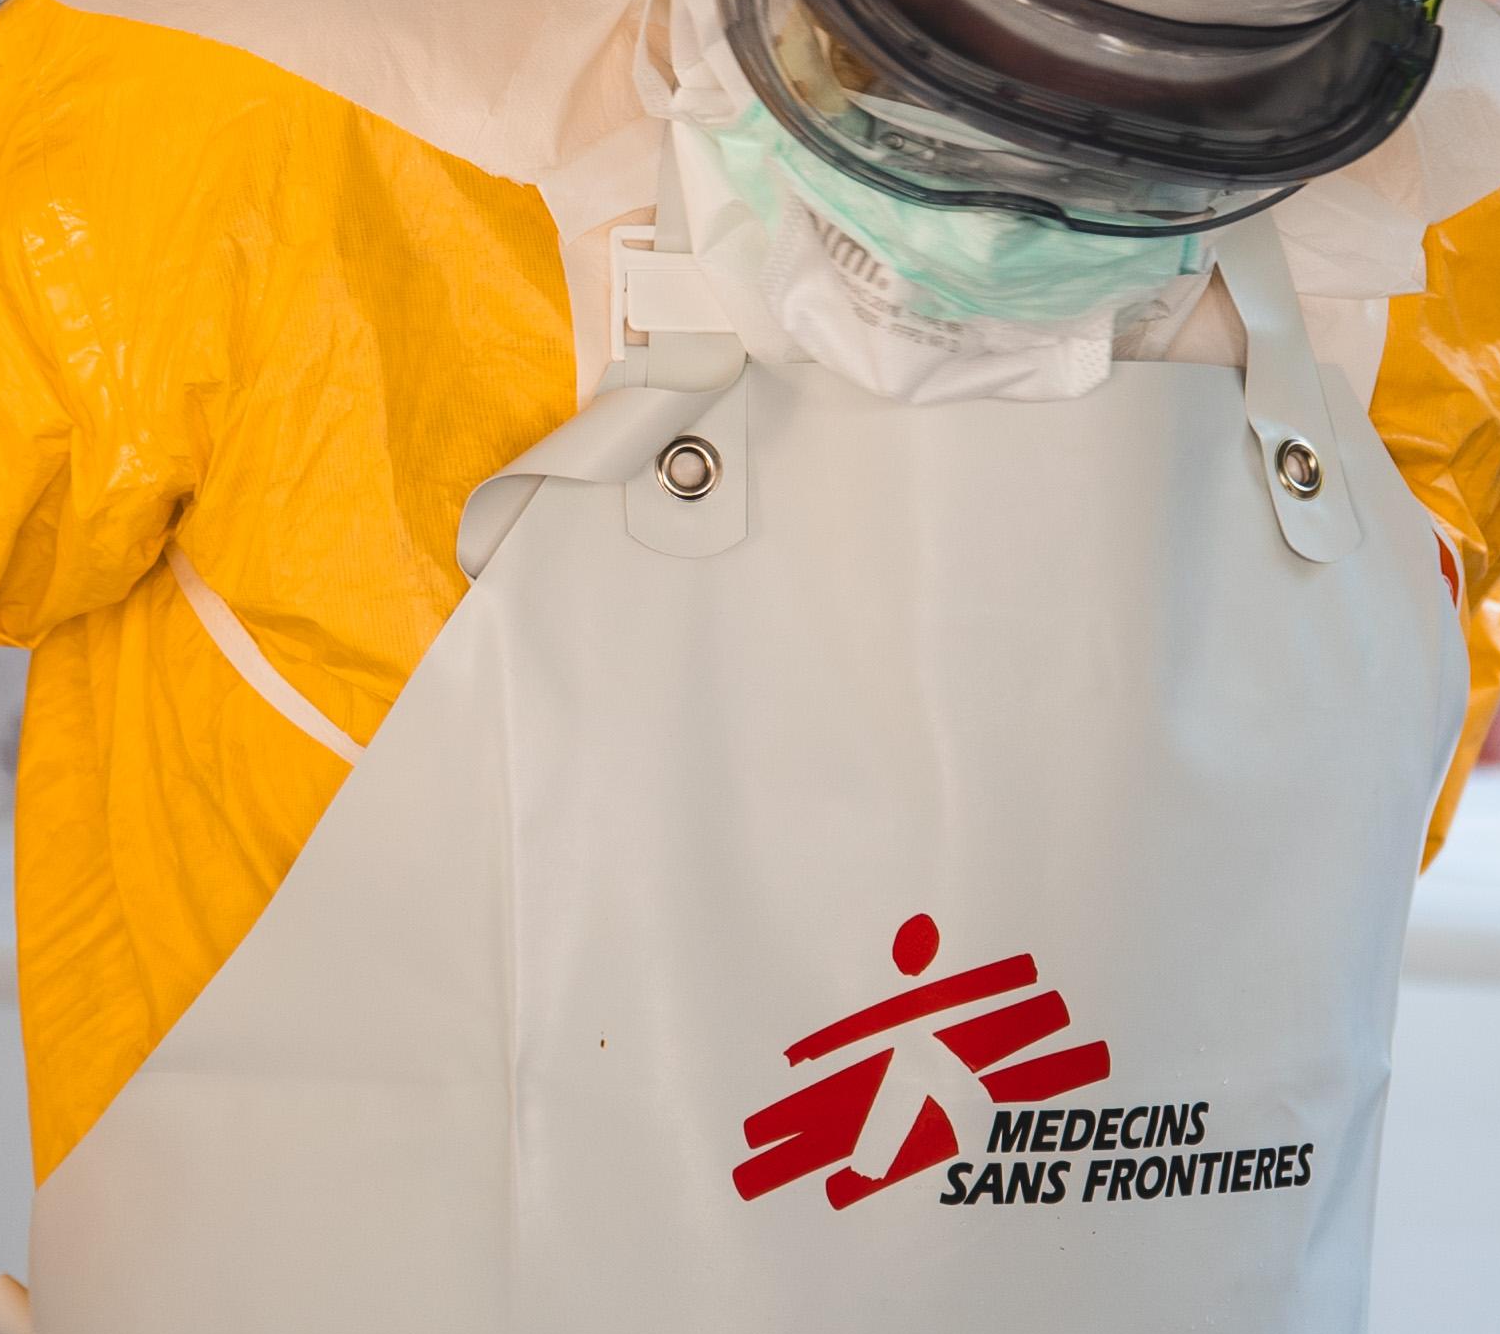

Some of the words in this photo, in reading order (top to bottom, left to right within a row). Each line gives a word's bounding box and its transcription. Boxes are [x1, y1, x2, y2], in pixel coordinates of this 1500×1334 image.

[986, 1101, 1208, 1153] MEDECINS
[940, 1161, 1071, 1205] SANS
[1082, 1142, 1313, 1203] FRONTIERES
